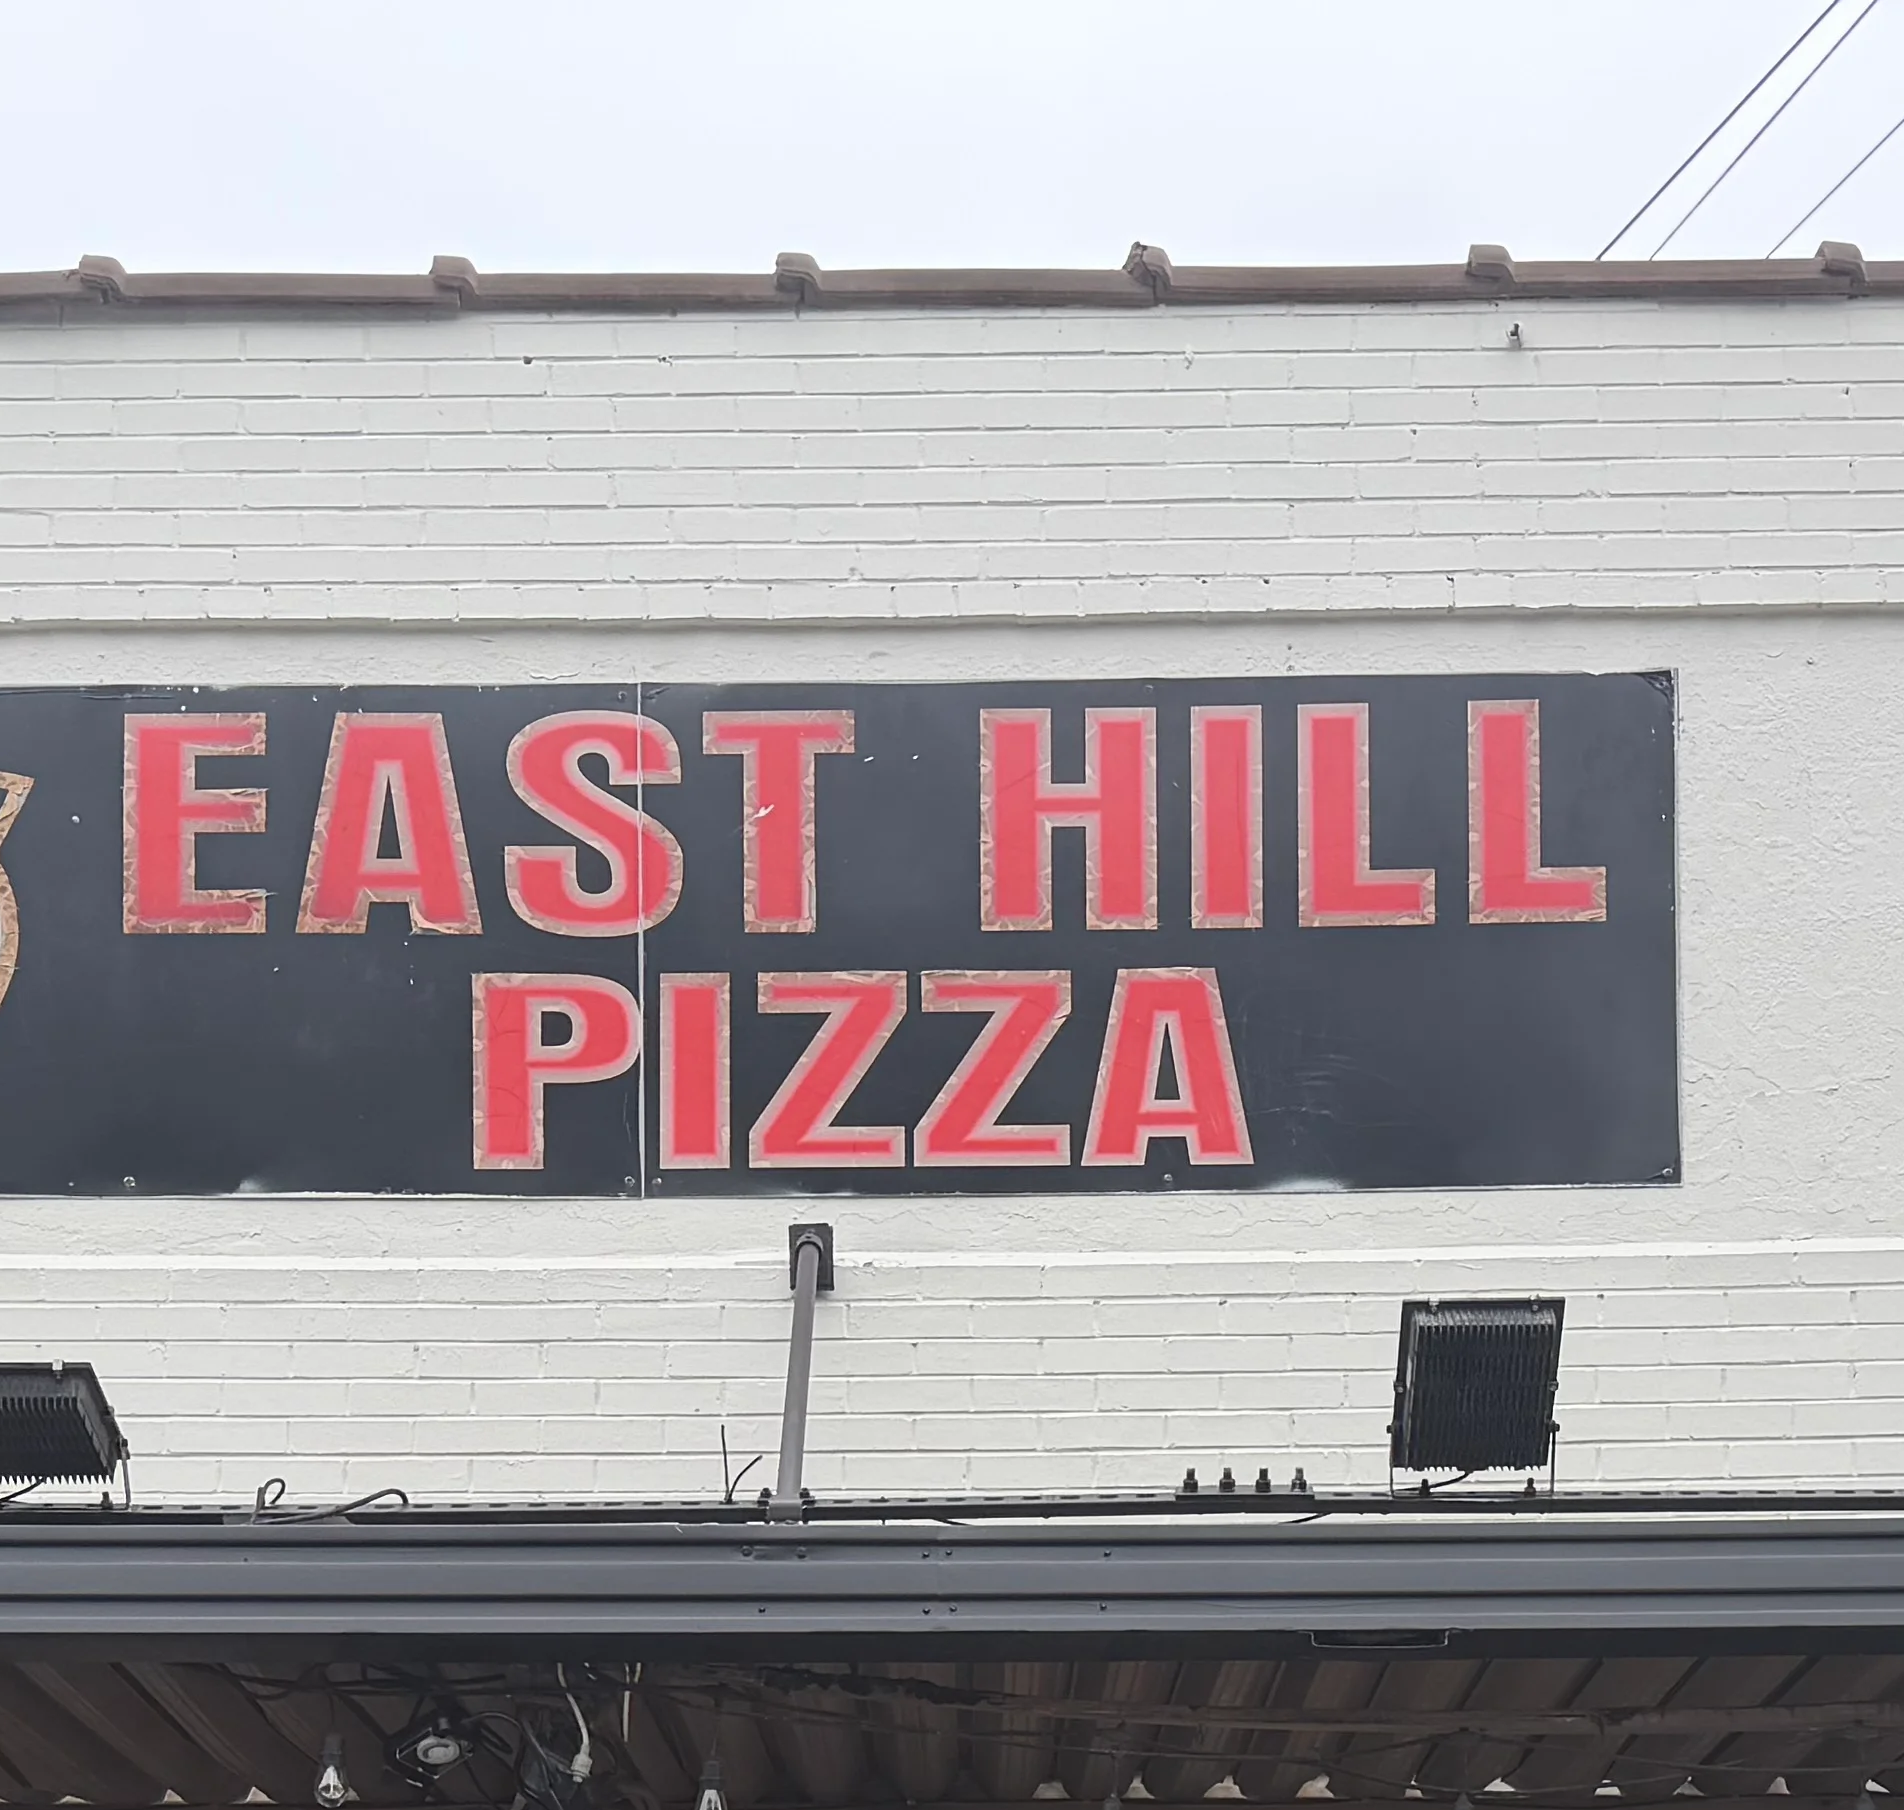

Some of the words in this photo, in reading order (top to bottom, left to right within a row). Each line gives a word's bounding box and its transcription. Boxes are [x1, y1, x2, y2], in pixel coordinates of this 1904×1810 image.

[122, 710, 855, 938] EAST
[980, 700, 1606, 931] HILL
[472, 967, 1254, 1170] PIZZA
